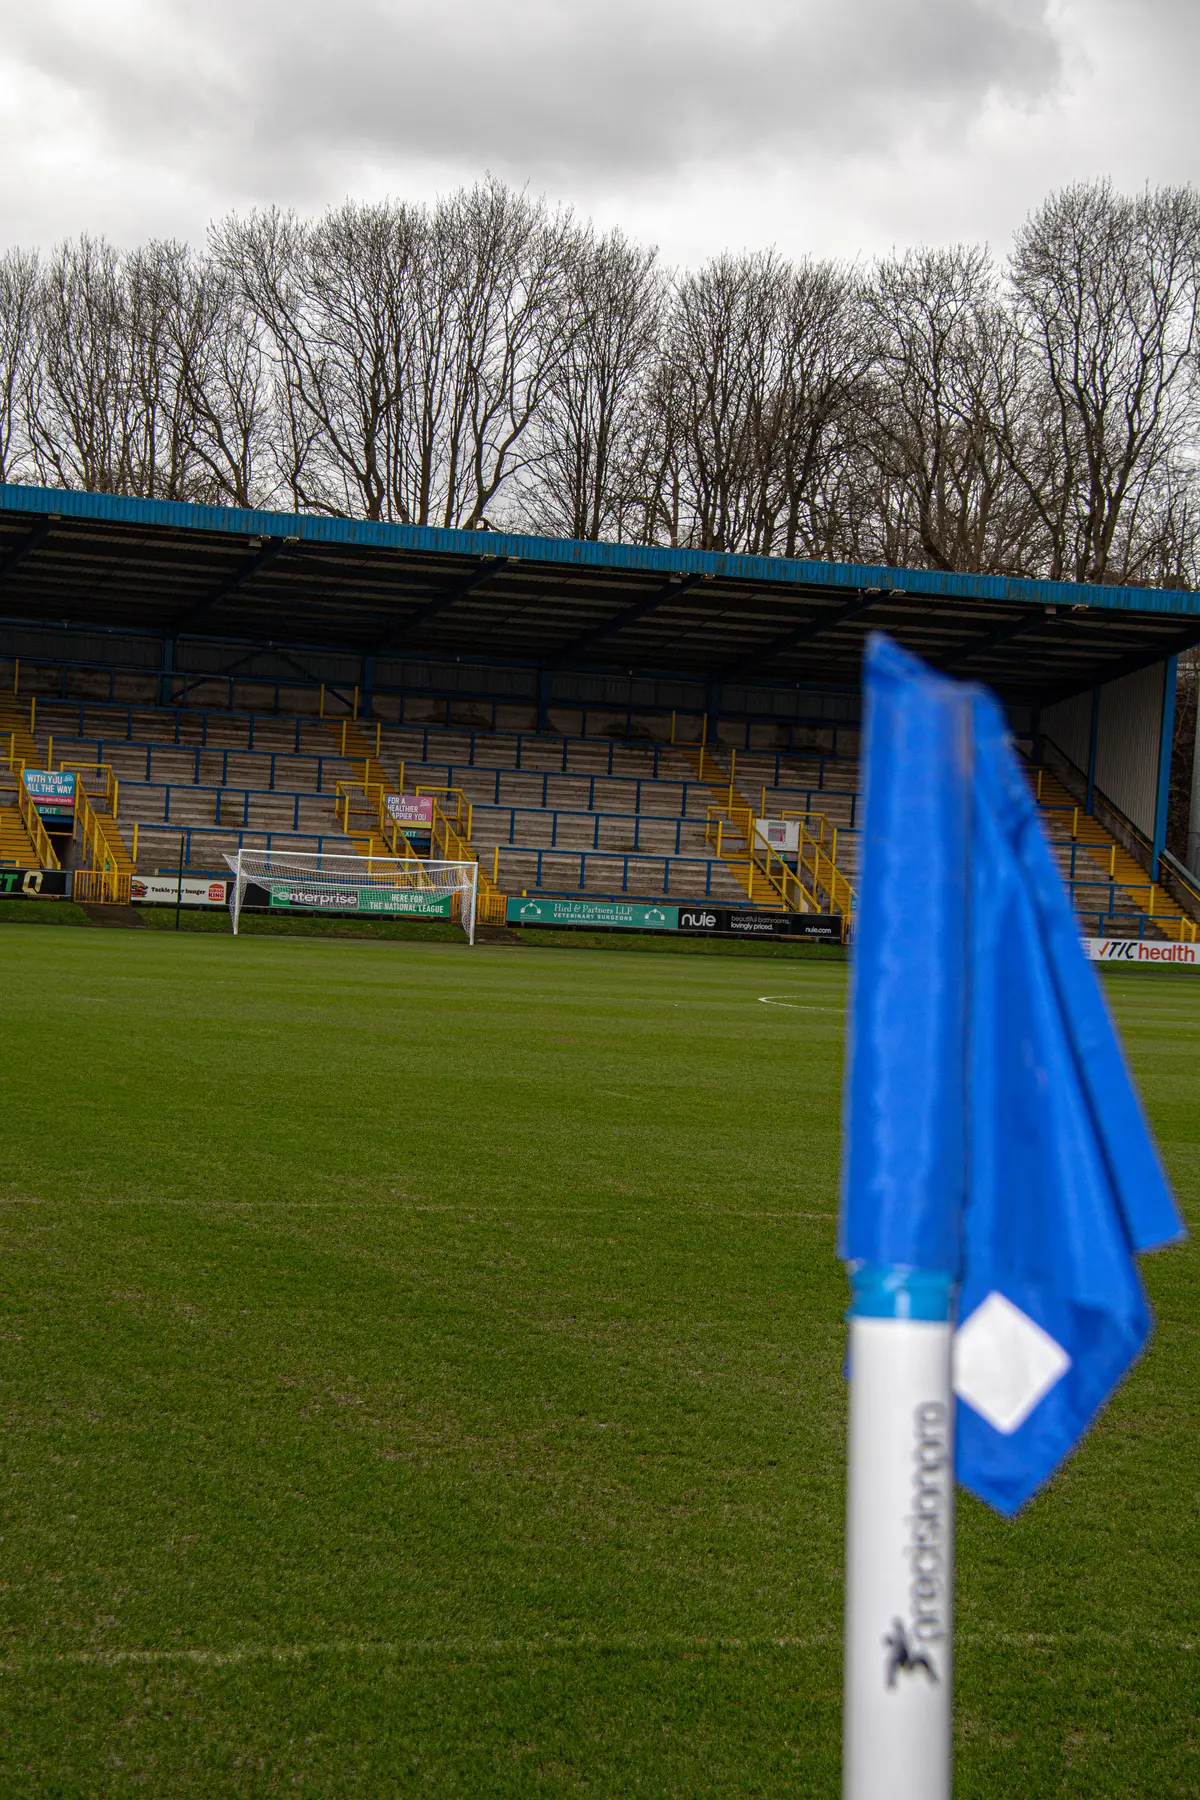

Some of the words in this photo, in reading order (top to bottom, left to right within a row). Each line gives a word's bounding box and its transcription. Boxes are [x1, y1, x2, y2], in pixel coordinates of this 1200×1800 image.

[27, 774, 46, 783] WITH
[48, 775, 63, 785] YOU
[27, 783, 40, 792] ALL
[41, 784, 55, 793] THE
[56, 785, 72, 794] WAY
[39, 806, 57, 815] EXIT
[387, 804, 419, 813] HEALTHIER
[414, 813, 427, 821] YOU
[277, 891, 357, 905] enterprise
[391, 893, 408, 902] HERE
[410, 895, 423, 903] FOR
[370, 901, 383, 910] THE
[384, 902, 417, 912] NATIONAL
[418, 904, 444, 913] LEAGUE
[554, 903, 572, 913] Hird
[573, 904, 581, 912] &
[582, 905, 614, 914] Partners
[615, 906, 633, 915] LLP
[553, 912, 595, 920] VETERINARY
[681, 912, 717, 927] nuie
[731, 915, 757, 923] beautiful
[730, 922, 753, 931] lovingly
[753, 923, 774, 931] priced.
[805, 926, 832, 934] nuie.com
[1138, 943, 1195, 962] health
